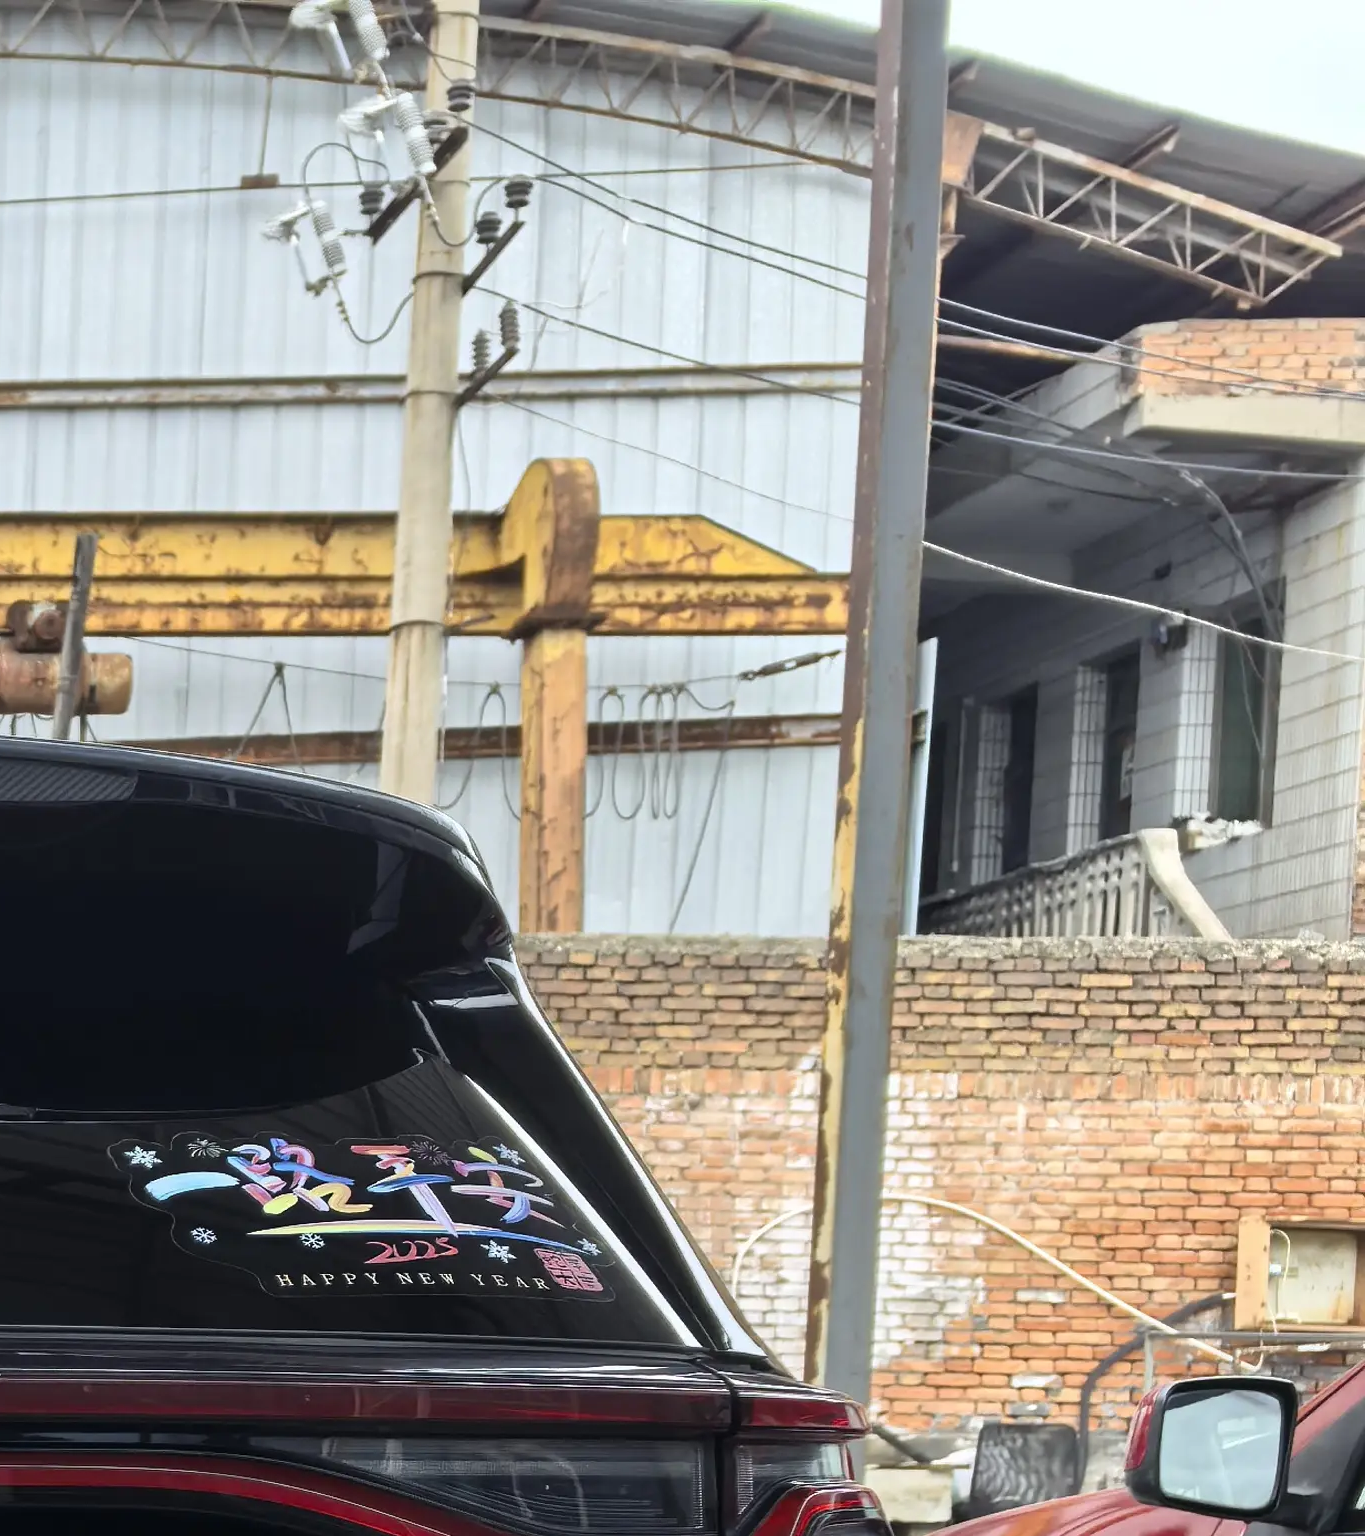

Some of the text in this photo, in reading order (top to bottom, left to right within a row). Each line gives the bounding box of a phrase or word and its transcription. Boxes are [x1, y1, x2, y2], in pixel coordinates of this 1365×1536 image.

[364, 1237, 459, 1264] 2025
[275, 1271, 551, 1291] HAPPY NEW YEAR
